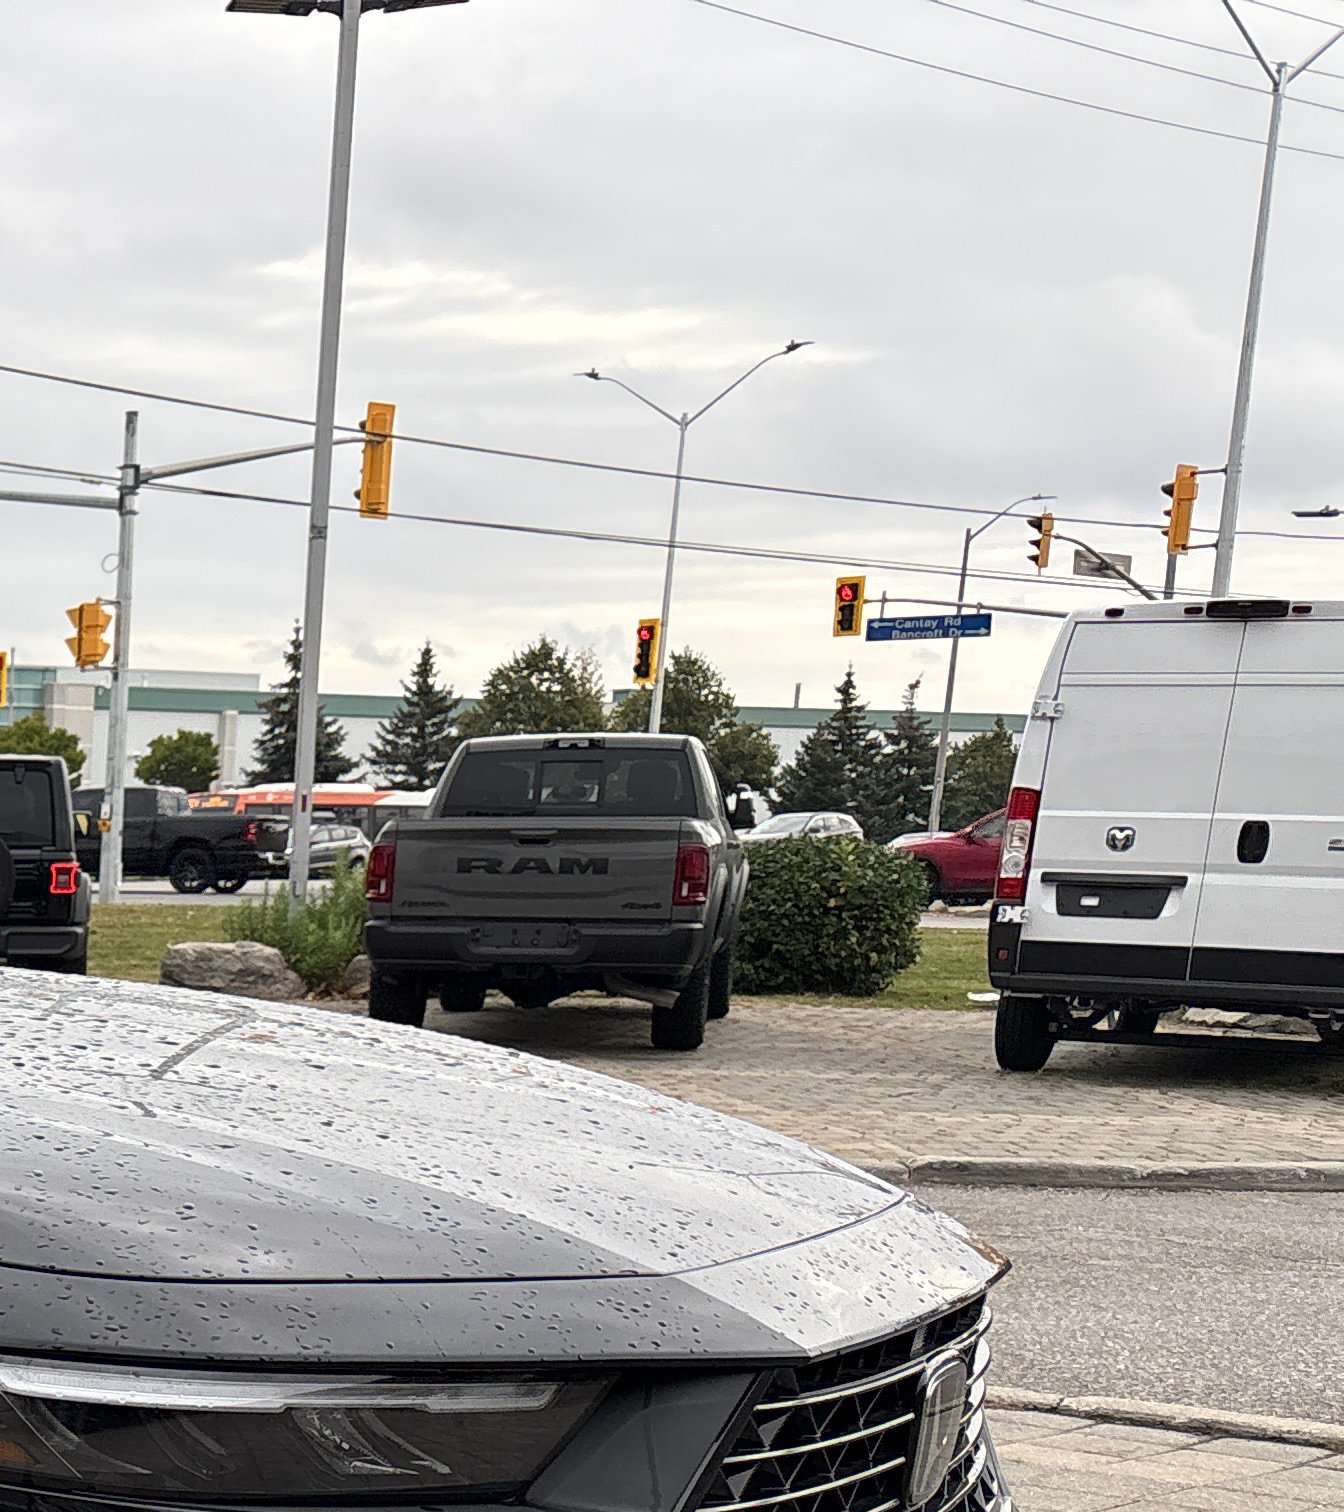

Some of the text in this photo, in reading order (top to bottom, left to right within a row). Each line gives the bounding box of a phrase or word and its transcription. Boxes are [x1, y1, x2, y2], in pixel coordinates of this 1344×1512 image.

[895, 616, 962, 630] Cantay Rd
[891, 628, 963, 640] Bancroft Dr
[456, 857, 610, 875] RAM
